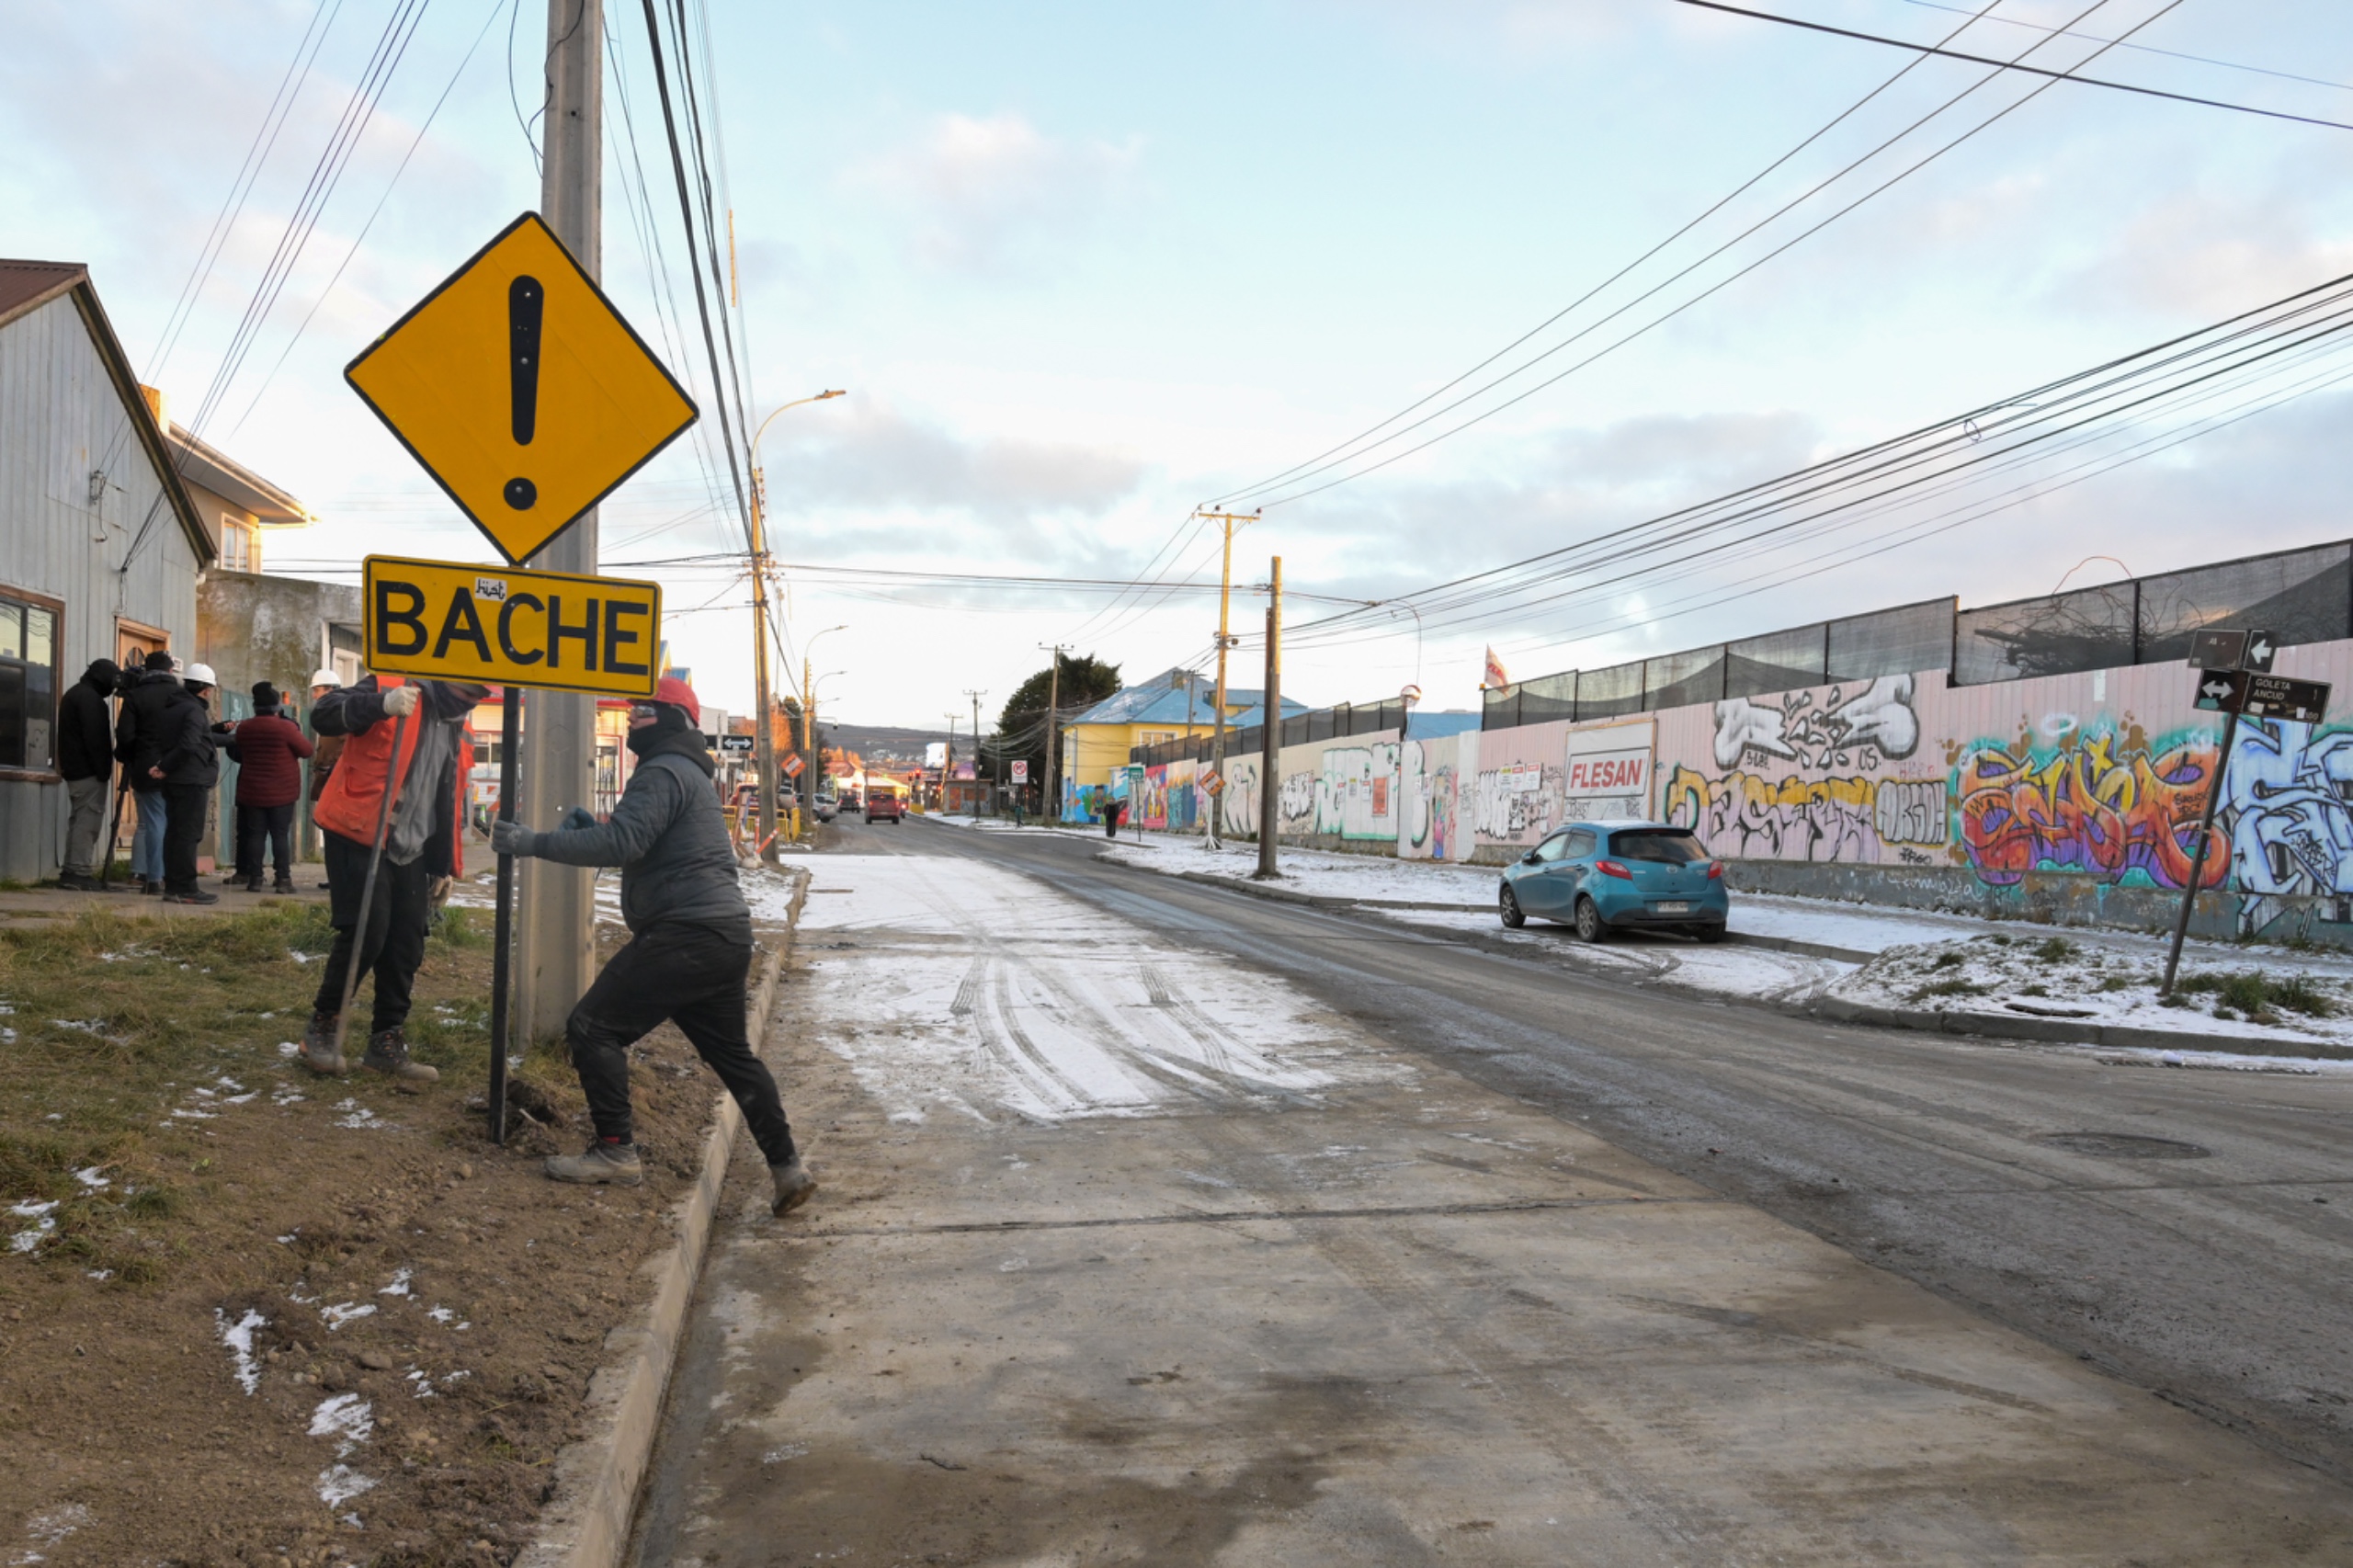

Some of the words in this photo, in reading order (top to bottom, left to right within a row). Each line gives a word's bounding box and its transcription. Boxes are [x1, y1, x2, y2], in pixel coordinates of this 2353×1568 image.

[376, 580, 649, 676] BACHE
[2253, 688, 2285, 700] ANCUD
[2255, 678, 2291, 691] GOLETA
[1570, 758, 1643, 789] FLESAN
